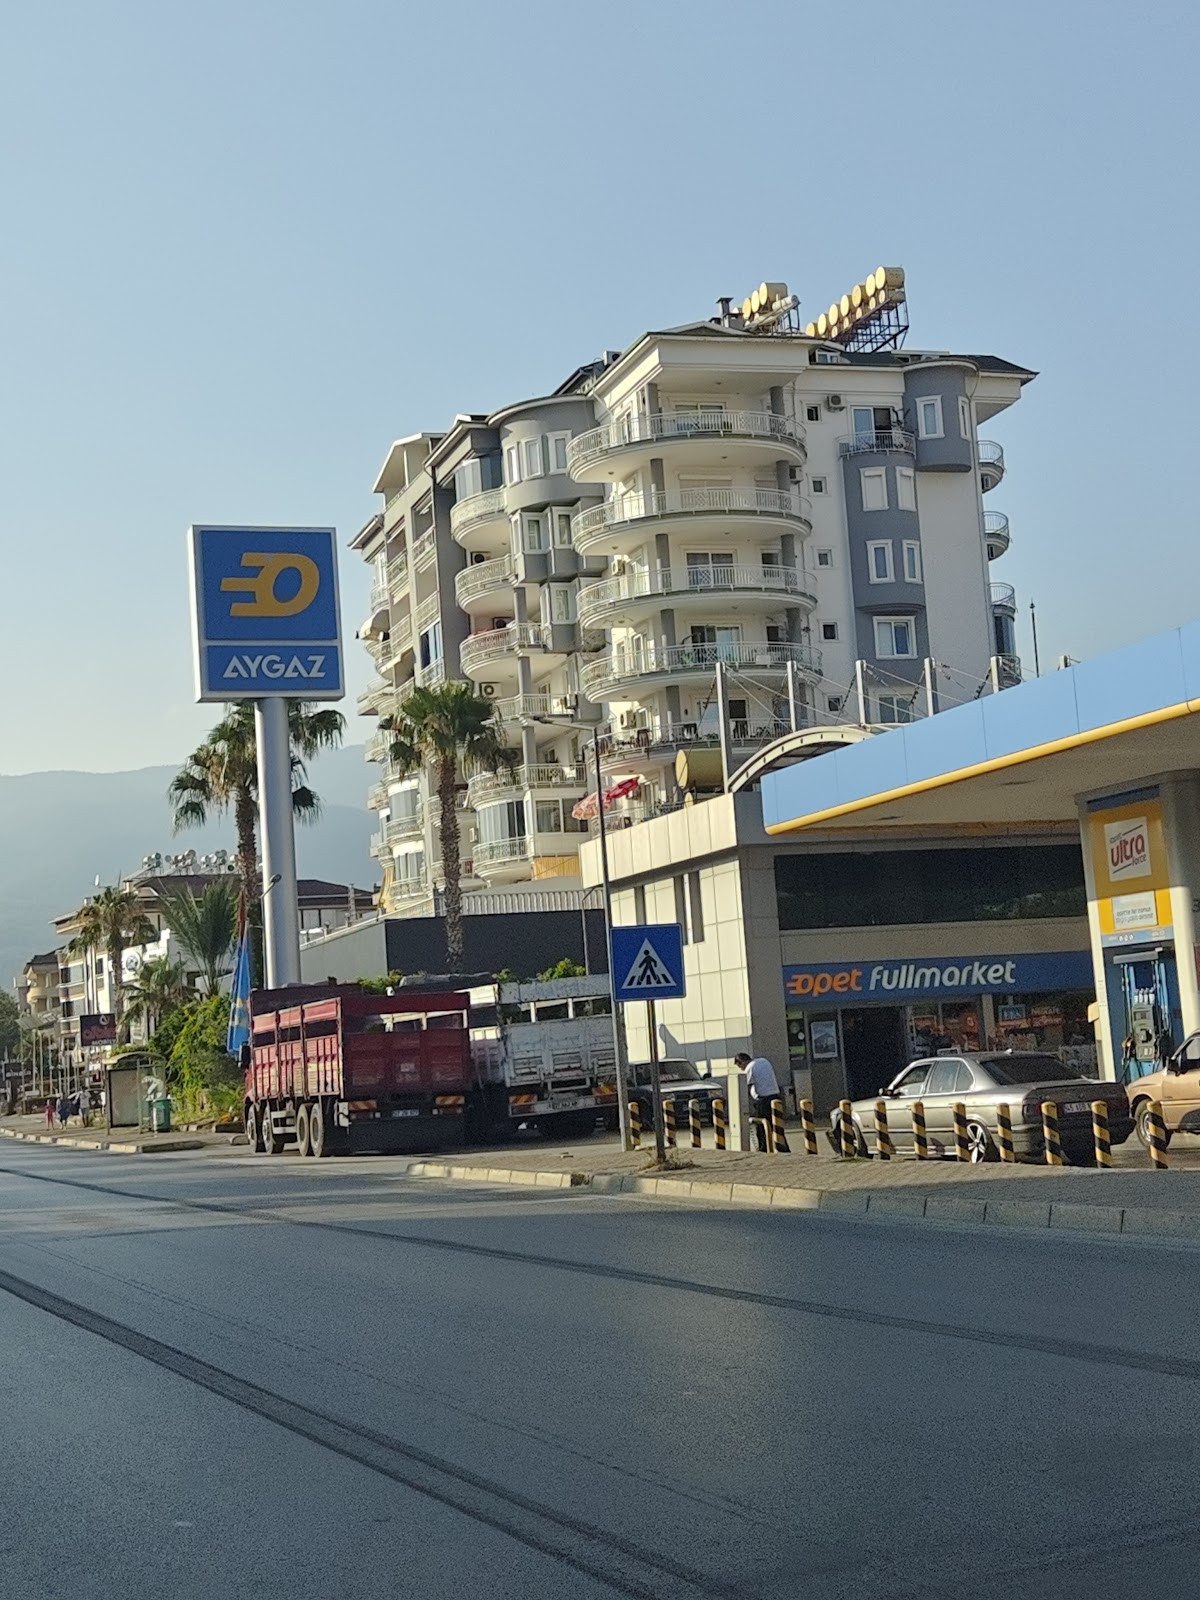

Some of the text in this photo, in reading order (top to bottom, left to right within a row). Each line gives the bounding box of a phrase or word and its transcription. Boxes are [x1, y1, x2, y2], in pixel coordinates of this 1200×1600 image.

[223, 655, 325, 678] AYGAZ
[1111, 834, 1145, 867] ultra
[786, 961, 1016, 996] opet fullmarket
